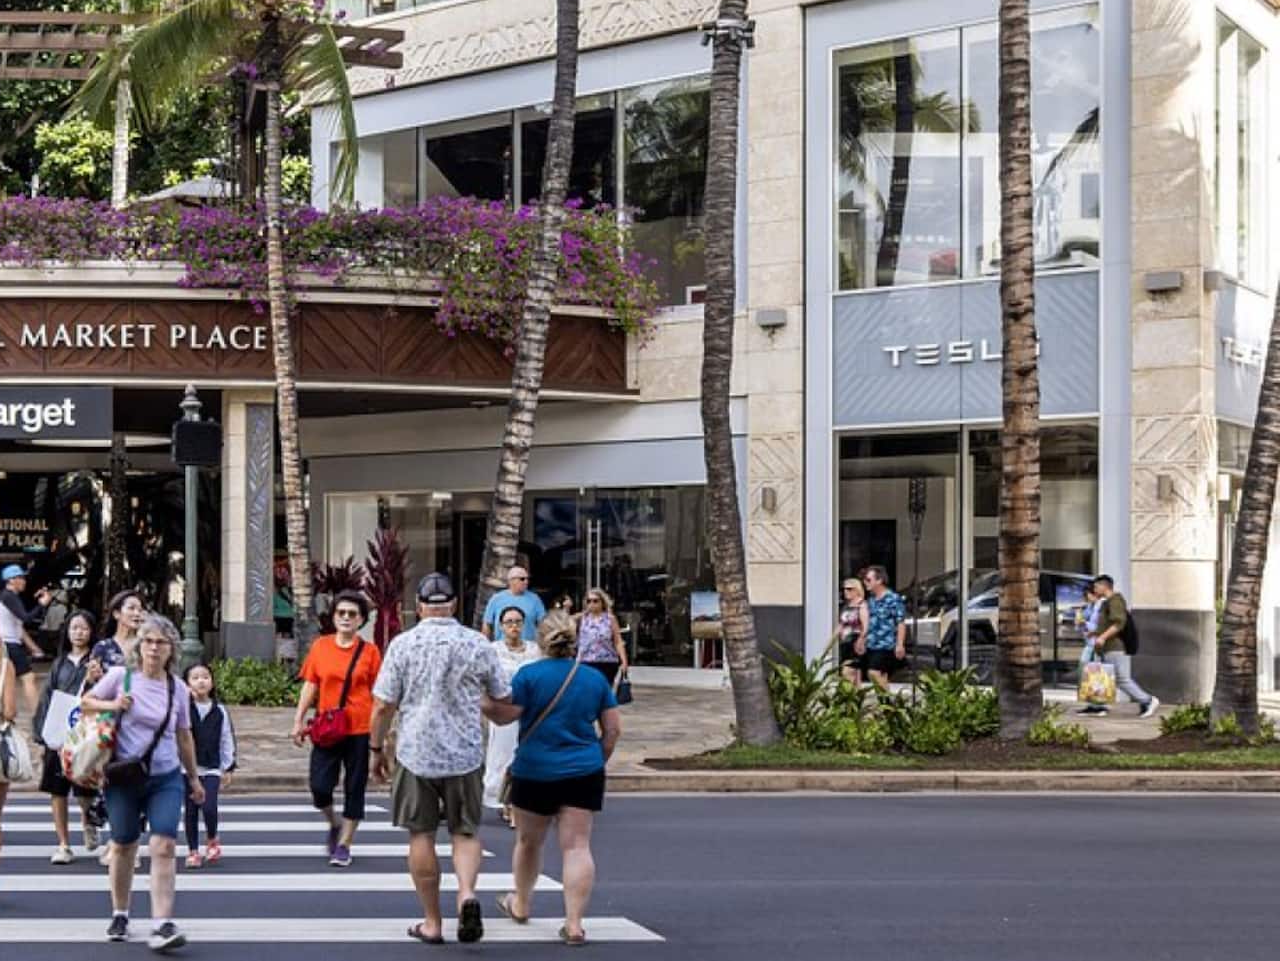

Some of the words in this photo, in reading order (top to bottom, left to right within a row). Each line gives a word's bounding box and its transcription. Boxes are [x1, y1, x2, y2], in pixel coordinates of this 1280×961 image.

[20, 324, 157, 348] MARKET
[170, 325, 267, 349] PLACE
[882, 339, 1040, 367] TESL
